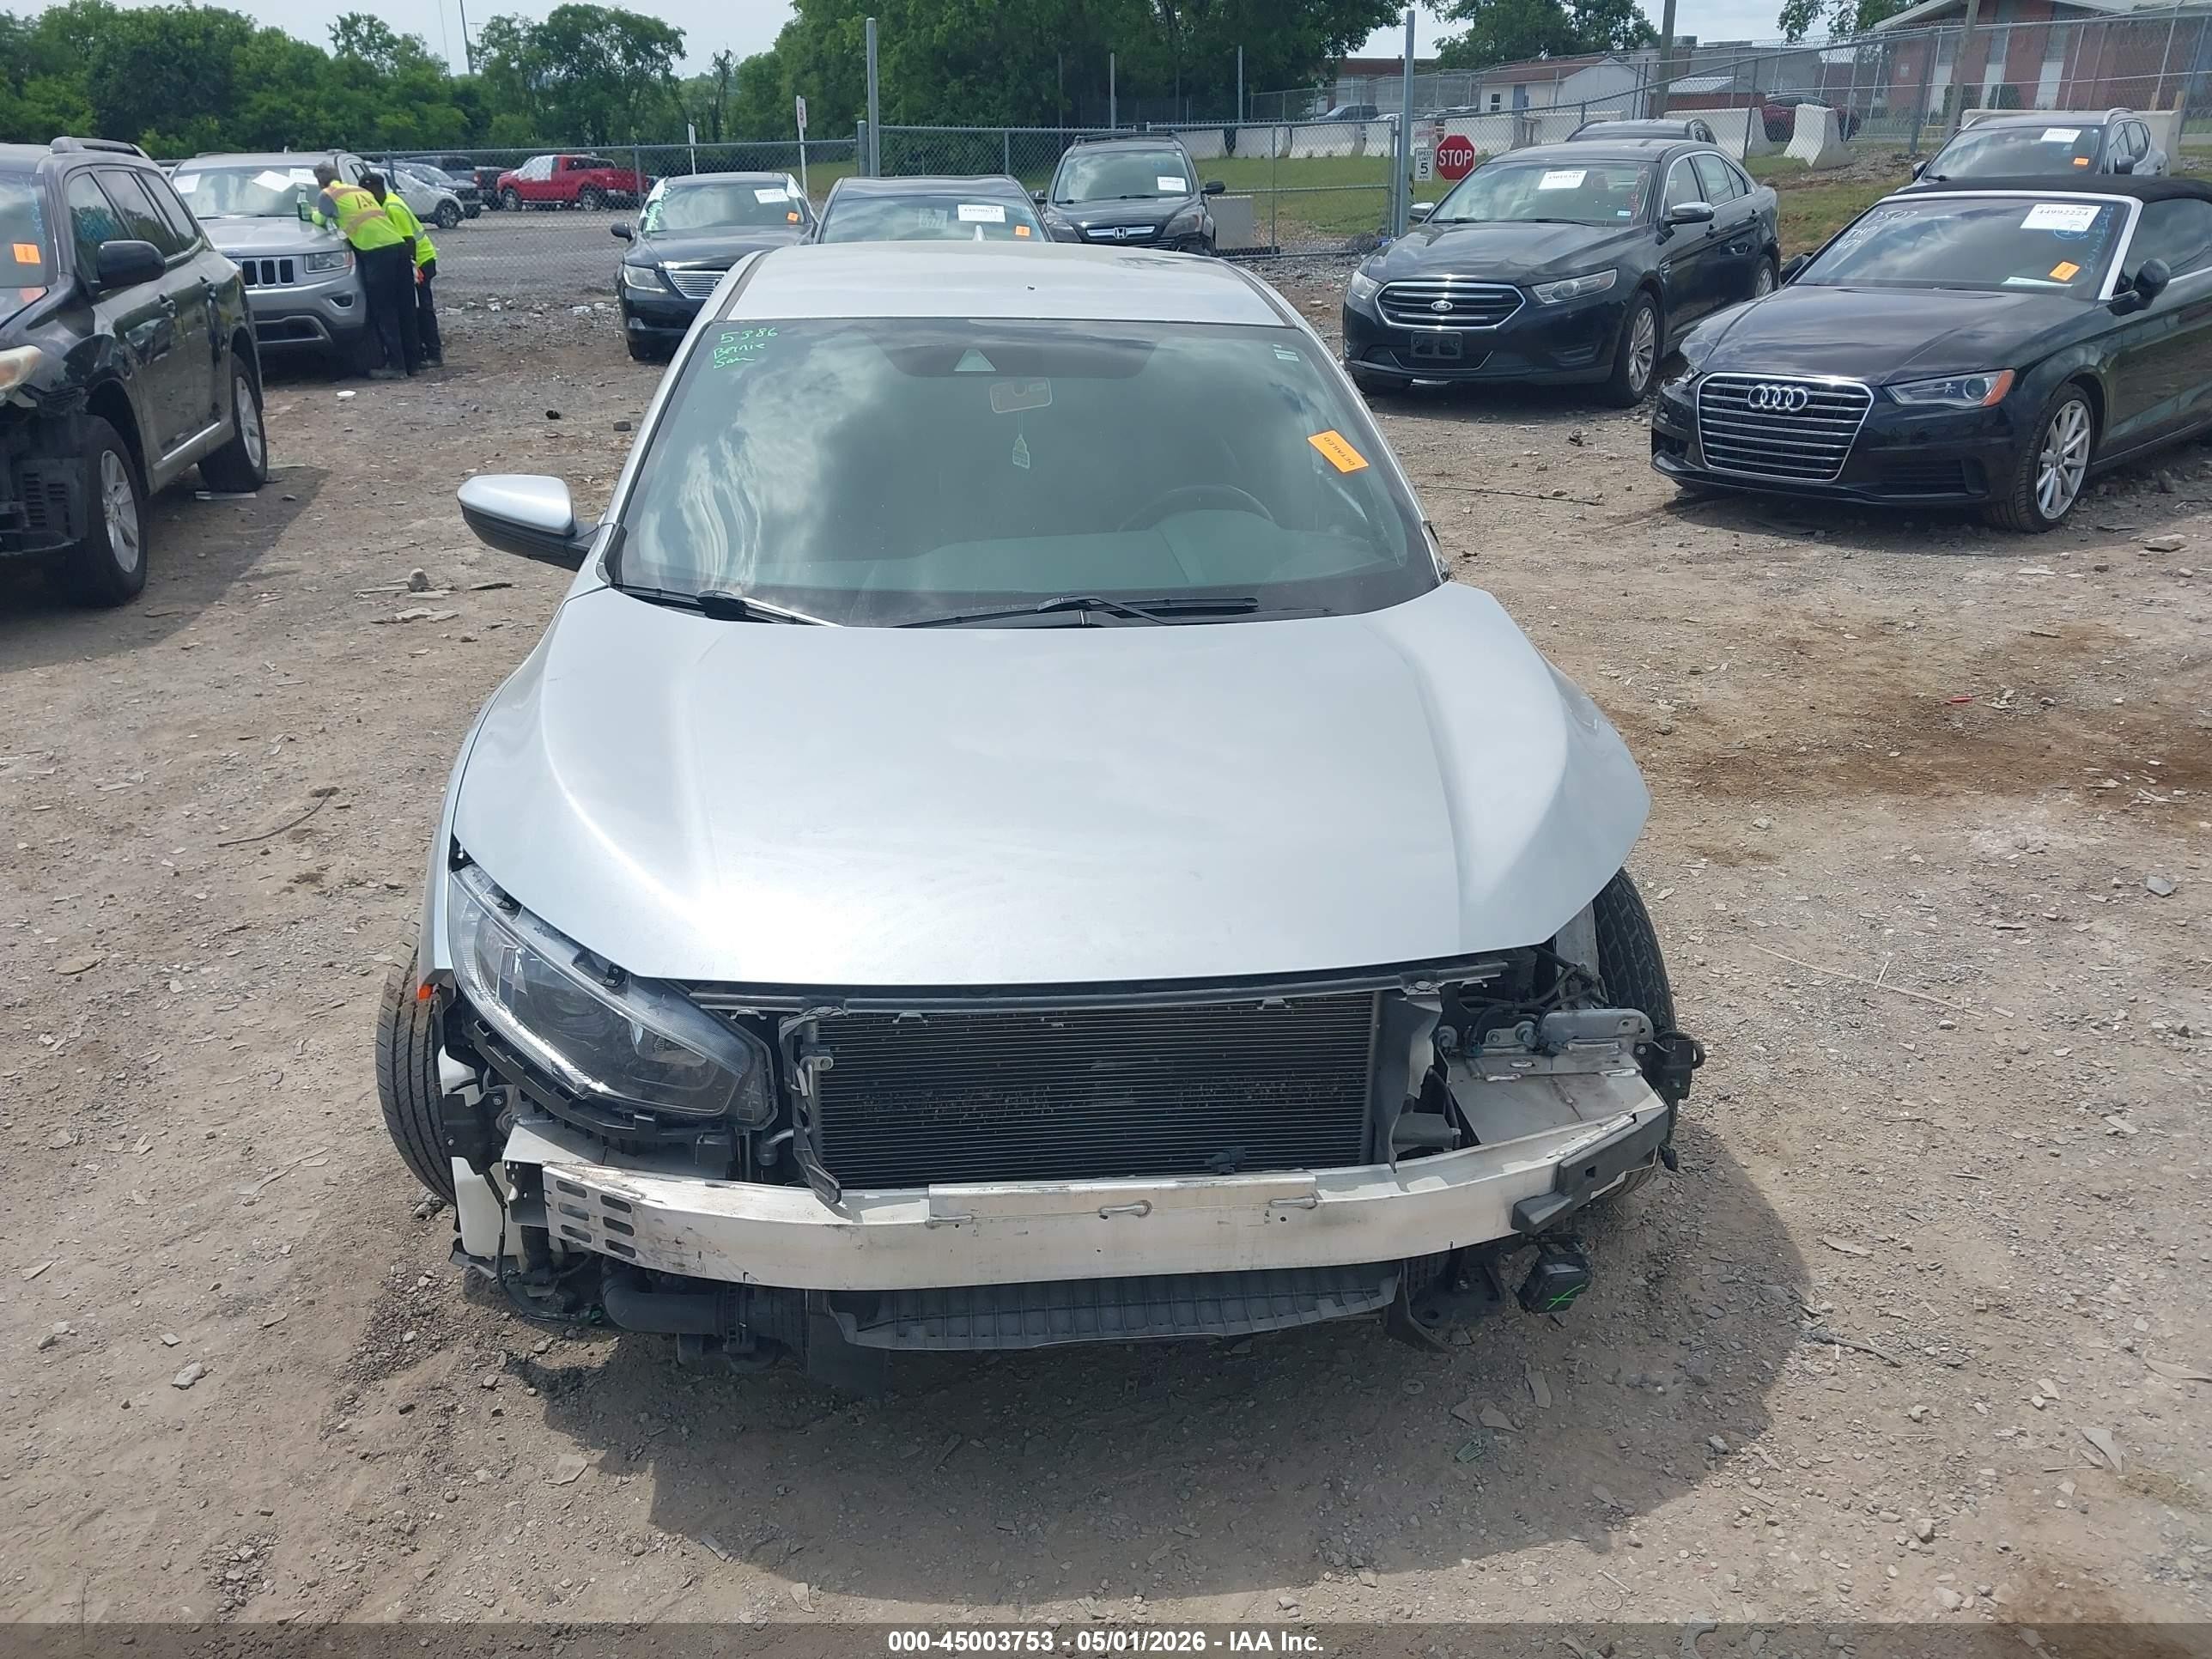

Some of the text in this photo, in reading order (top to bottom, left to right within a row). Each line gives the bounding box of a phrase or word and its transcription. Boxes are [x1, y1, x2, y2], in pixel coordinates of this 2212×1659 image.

[1438, 149, 1473, 167] STOP
[1420, 162, 1429, 174] 5
[720, 326, 779, 343] 5386
